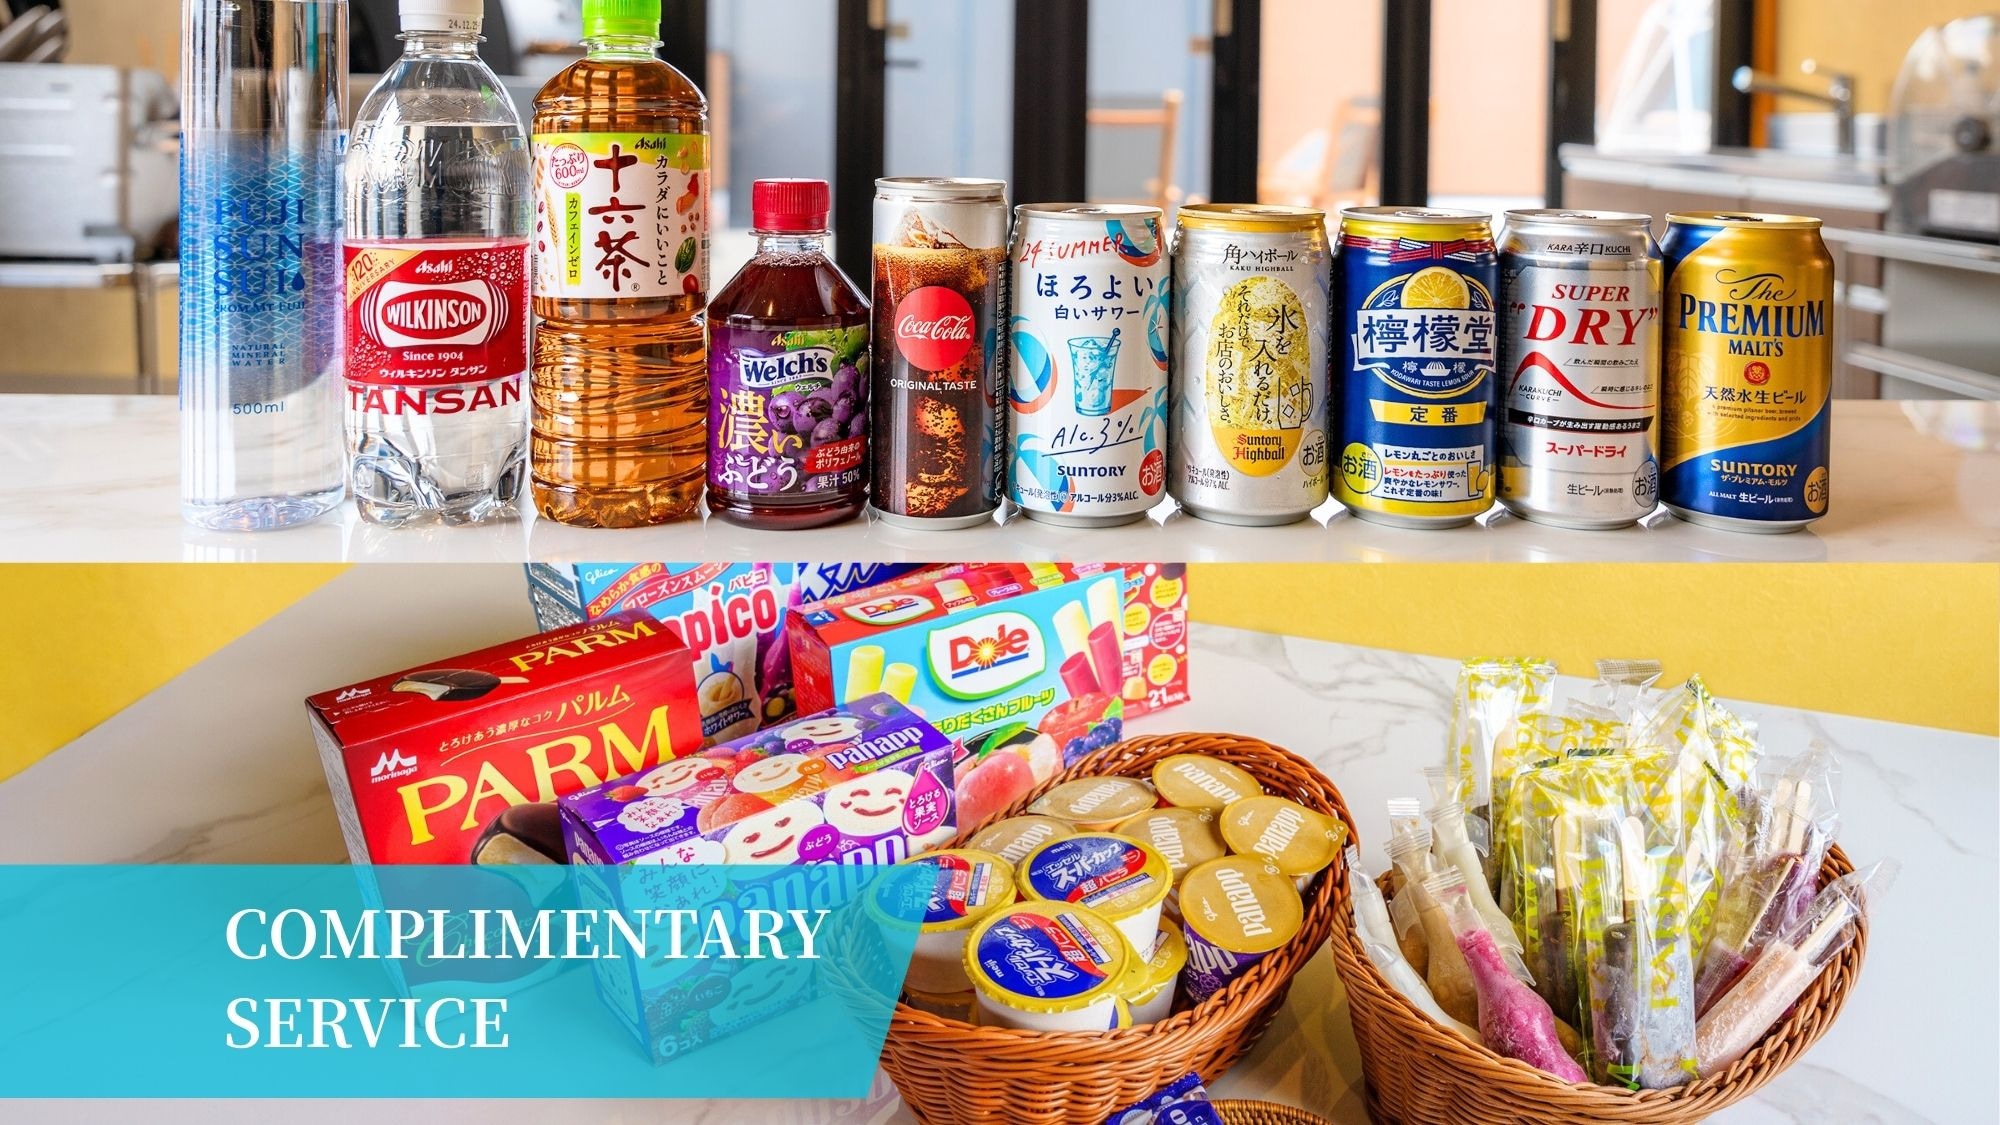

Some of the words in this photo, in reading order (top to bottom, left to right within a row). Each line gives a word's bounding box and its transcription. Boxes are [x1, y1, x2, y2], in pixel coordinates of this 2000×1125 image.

[634, 137, 667, 150] Asahi
[551, 151, 586, 168] たっぷり
[555, 164, 585, 180] 600ml
[215, 199, 305, 225] FUJI
[588, 144, 651, 293] 十六茶
[655, 155, 671, 286] カラダにいいこと
[214, 233, 305, 261] SUN
[568, 197, 581, 278] カフェインゼロ
[1222, 243, 1299, 265] 角ハイボール
[1546, 243, 1573, 252] KARA
[1573, 242, 1604, 255] 辛口
[1604, 245, 1631, 253] KUCHI
[415, 260, 453, 275] Asahi
[213, 269, 289, 296] SUI
[1036, 272, 1154, 300] ほろよい
[1715, 268, 1797, 302] The
[1551, 283, 1631, 302] SUPER
[213, 303, 249, 312] FROM
[386, 298, 482, 330] WILKINSON
[1054, 304, 1140, 321] 白いサワー
[1679, 292, 1825, 338] PREMIUM
[897, 313, 972, 340] Coca-Cola
[1265, 304, 1300, 356] 氷を
[1362, 314, 1493, 354] 檸檬堂
[231, 343, 286, 351] NATURAL
[771, 333, 805, 347] Asahi
[1728, 338, 1784, 357] MALT'S
[231, 351, 287, 359] MINERAL
[231, 358, 286, 367] WATER
[402, 351, 435, 361] Since
[437, 351, 464, 362] 1904
[379, 368, 447, 379] ウィルキンソン
[450, 364, 488, 376] タンサン
[744, 352, 828, 383] Welch's
[890, 378, 942, 391] ORIGINAL
[943, 379, 978, 392] TASTE
[1390, 369, 1422, 386] KODAWARI
[1422, 378, 1441, 388] TASTE
[1441, 376, 1462, 388] LEMON
[347, 378, 521, 416] TANSAN
[1518, 384, 1563, 397] KARAKUCHI
[1703, 385, 1808, 405] 天然水生ビール
[232, 402, 285, 415] 500ml
[1409, 405, 1459, 424] 定番
[718, 387, 804, 455] 濃い
[1236, 433, 1282, 448] Suntory
[1545, 441, 1628, 458] スーパードライ
[1232, 446, 1286, 464] Highball
[1384, 448, 1477, 461] レモン丸ごとのおいしさ
[717, 453, 798, 492] ぶどう
[1057, 465, 1127, 477] SUNTORY
[1343, 454, 1378, 482] お酒
[1384, 467, 1467, 480] レモンをたっぷり使った
[1710, 458, 1798, 477] SUNTORY
[817, 474, 840, 489] 果汁
[842, 470, 860, 484] 50%
[1719, 492, 1738, 500] MALT
[728, 569, 769, 592] パピコ
[508, 621, 657, 673] PARM
[949, 624, 1030, 672] Dole
[438, 709, 554, 753] とろけあう濃厚なコク
[555, 684, 632, 723] パルム
[825, 725, 924, 771] panapp
[371, 766, 418, 784] morinaga
[396, 704, 678, 846] PARM
[909, 788, 942, 810] とろける
[1068, 779, 1132, 816] panapp
[914, 801, 938, 819] 果実
[914, 812, 940, 830] ソース
[806, 834, 833, 851] ぶどう
[999, 823, 1054, 863] anapp
[1252, 807, 1305, 861] panapp
[1051, 842, 1074, 855] meiji
[1043, 852, 1082, 875] エッセル
[1051, 841, 1126, 891] スーパーカップ
[1214, 867, 1274, 938] panapp
